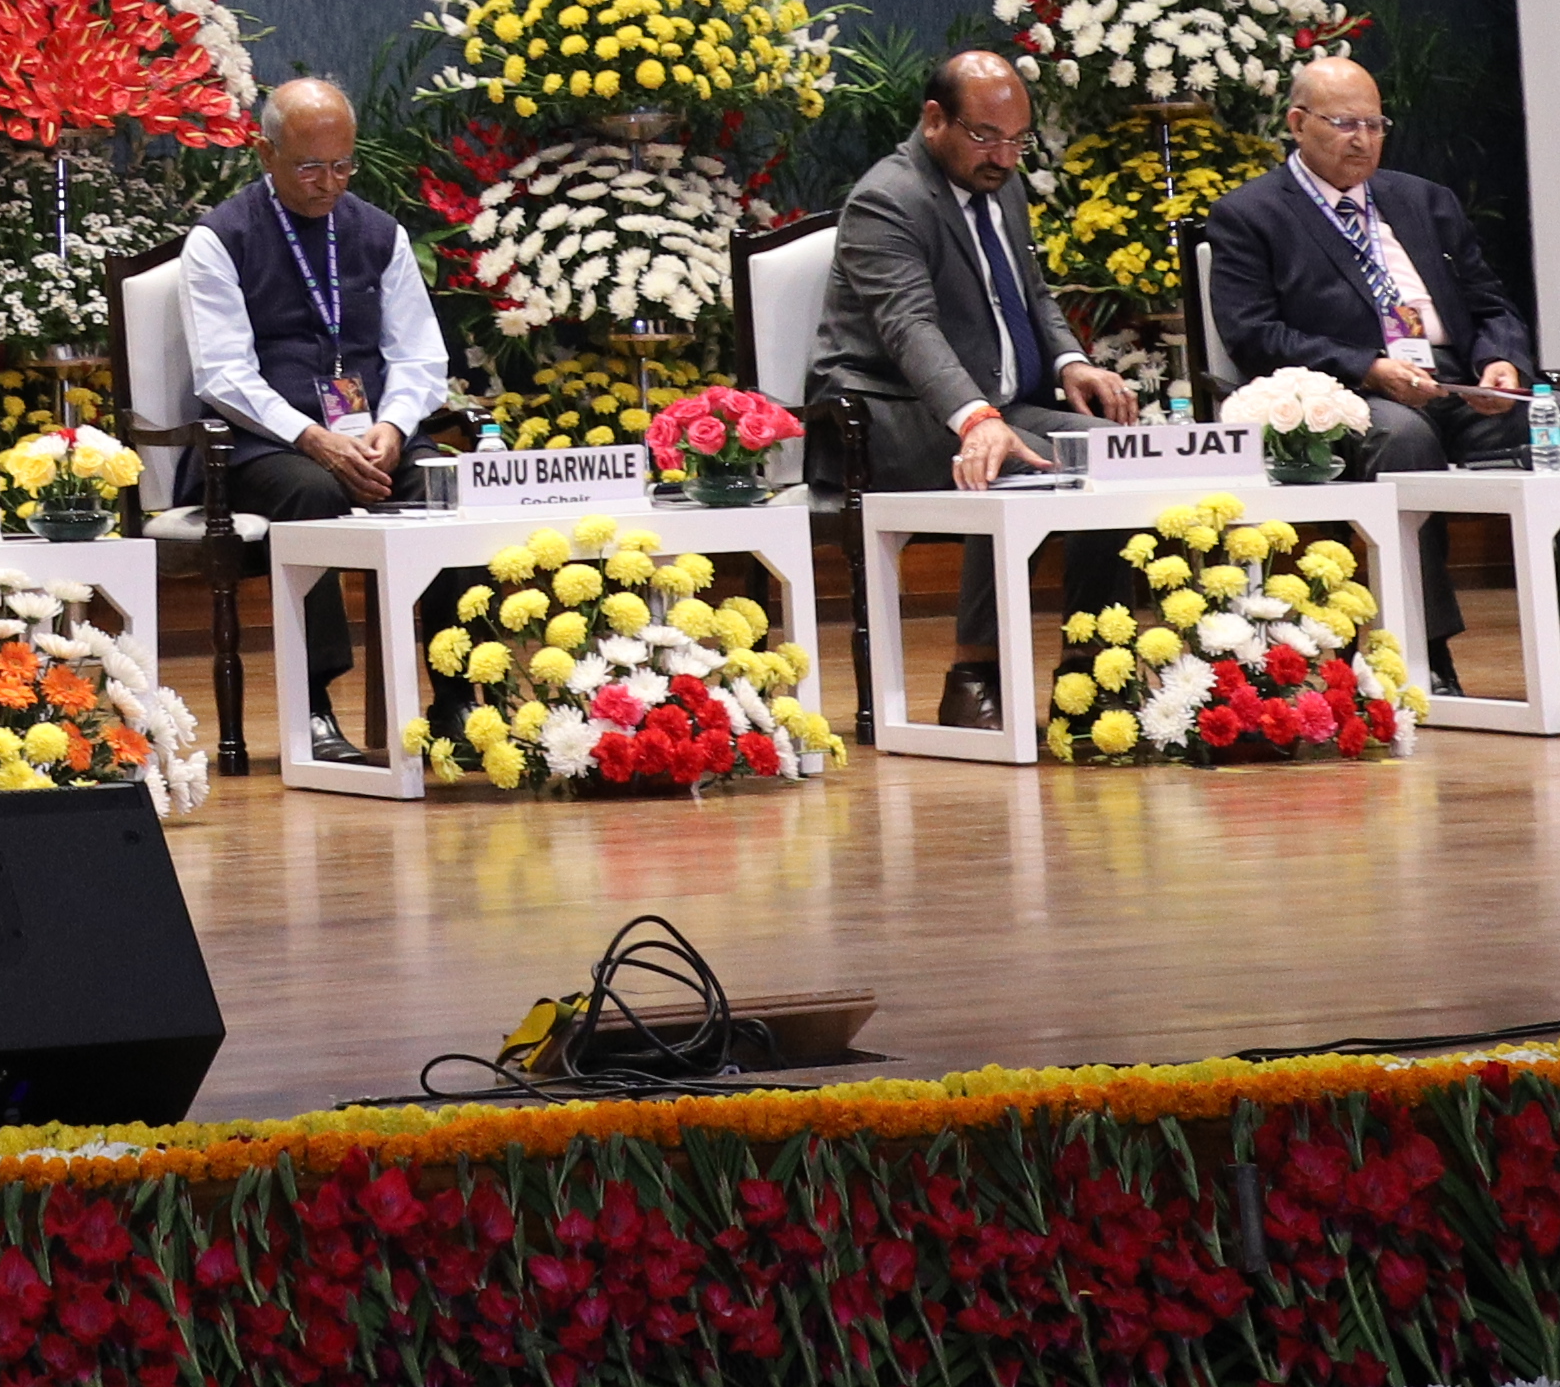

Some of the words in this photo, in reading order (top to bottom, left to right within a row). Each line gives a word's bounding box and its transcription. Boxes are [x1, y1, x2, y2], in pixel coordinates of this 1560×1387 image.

[1107, 434, 1162, 459] ML
[1176, 429, 1249, 457] JAT
[473, 459, 528, 487] RAJU
[536, 453, 636, 484] BARWALE
